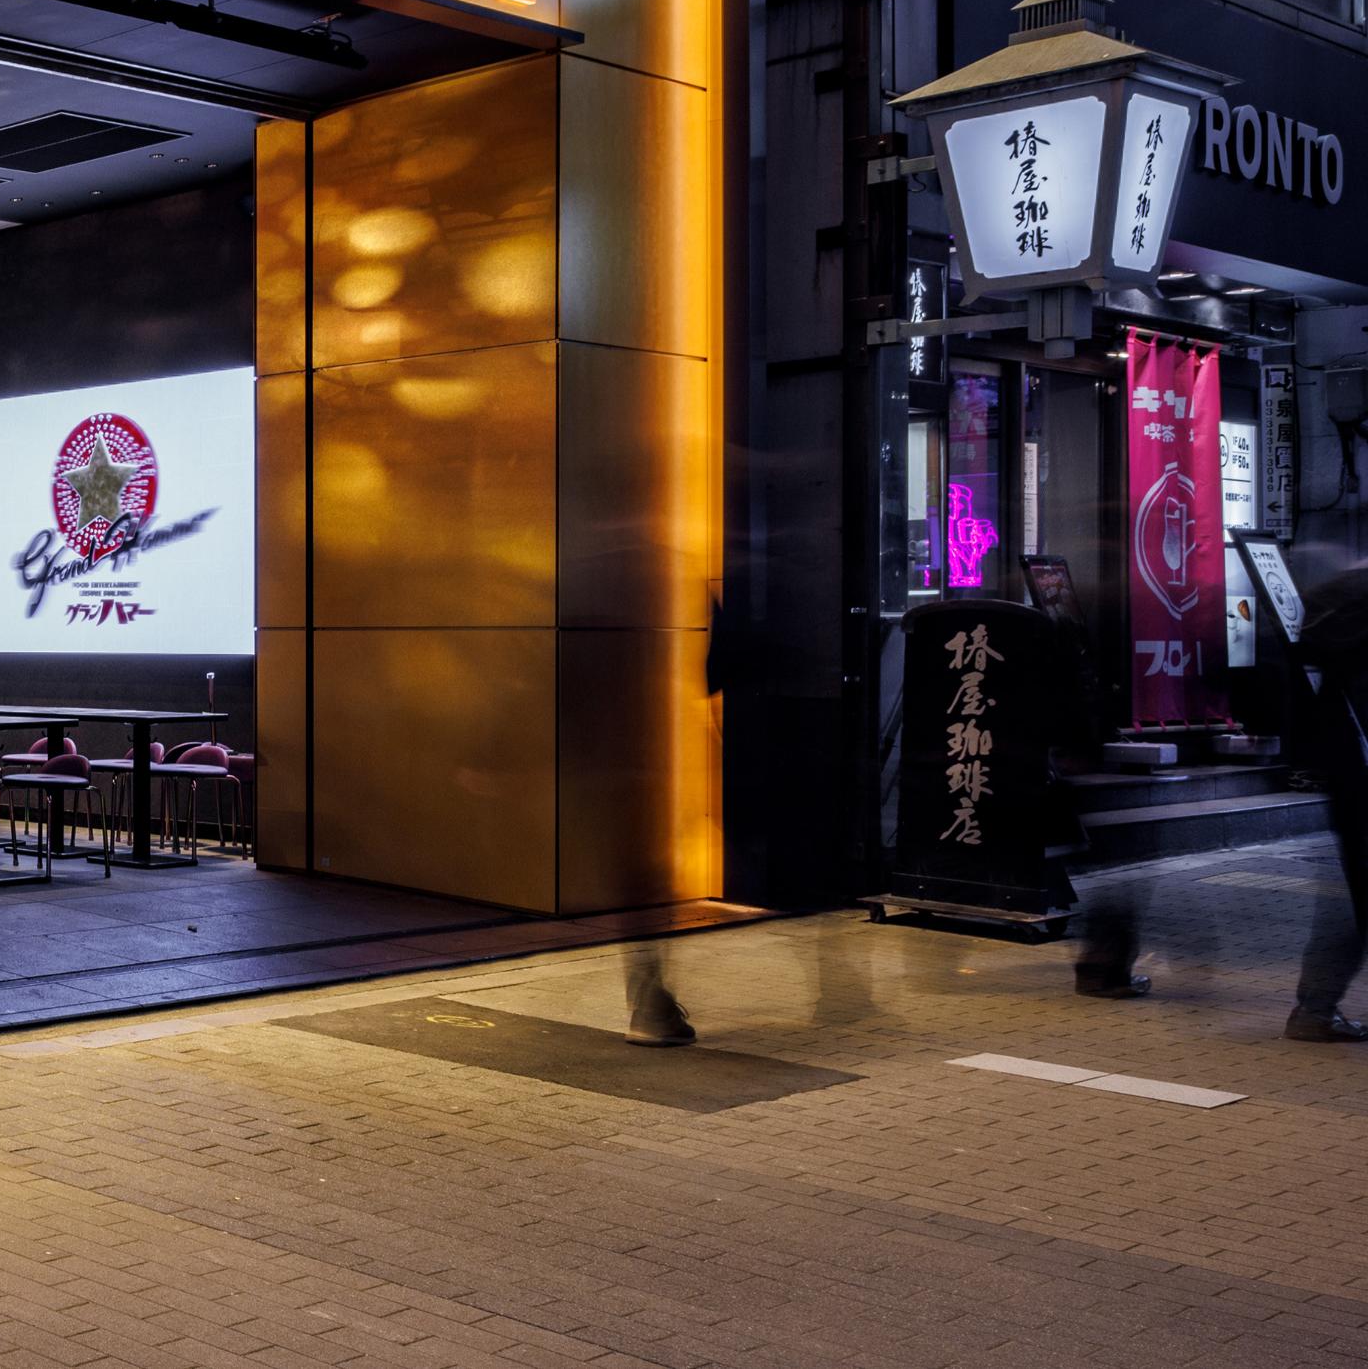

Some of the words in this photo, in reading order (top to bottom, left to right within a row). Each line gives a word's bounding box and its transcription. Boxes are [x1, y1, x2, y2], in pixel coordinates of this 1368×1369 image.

[1004, 121, 1053, 257] 椿屋珈琲
[1130, 114, 1163, 255] 椿屋珈琲
[1198, 97, 1344, 205] RONTO
[939, 624, 1005, 845] 椿屋珈琲店
